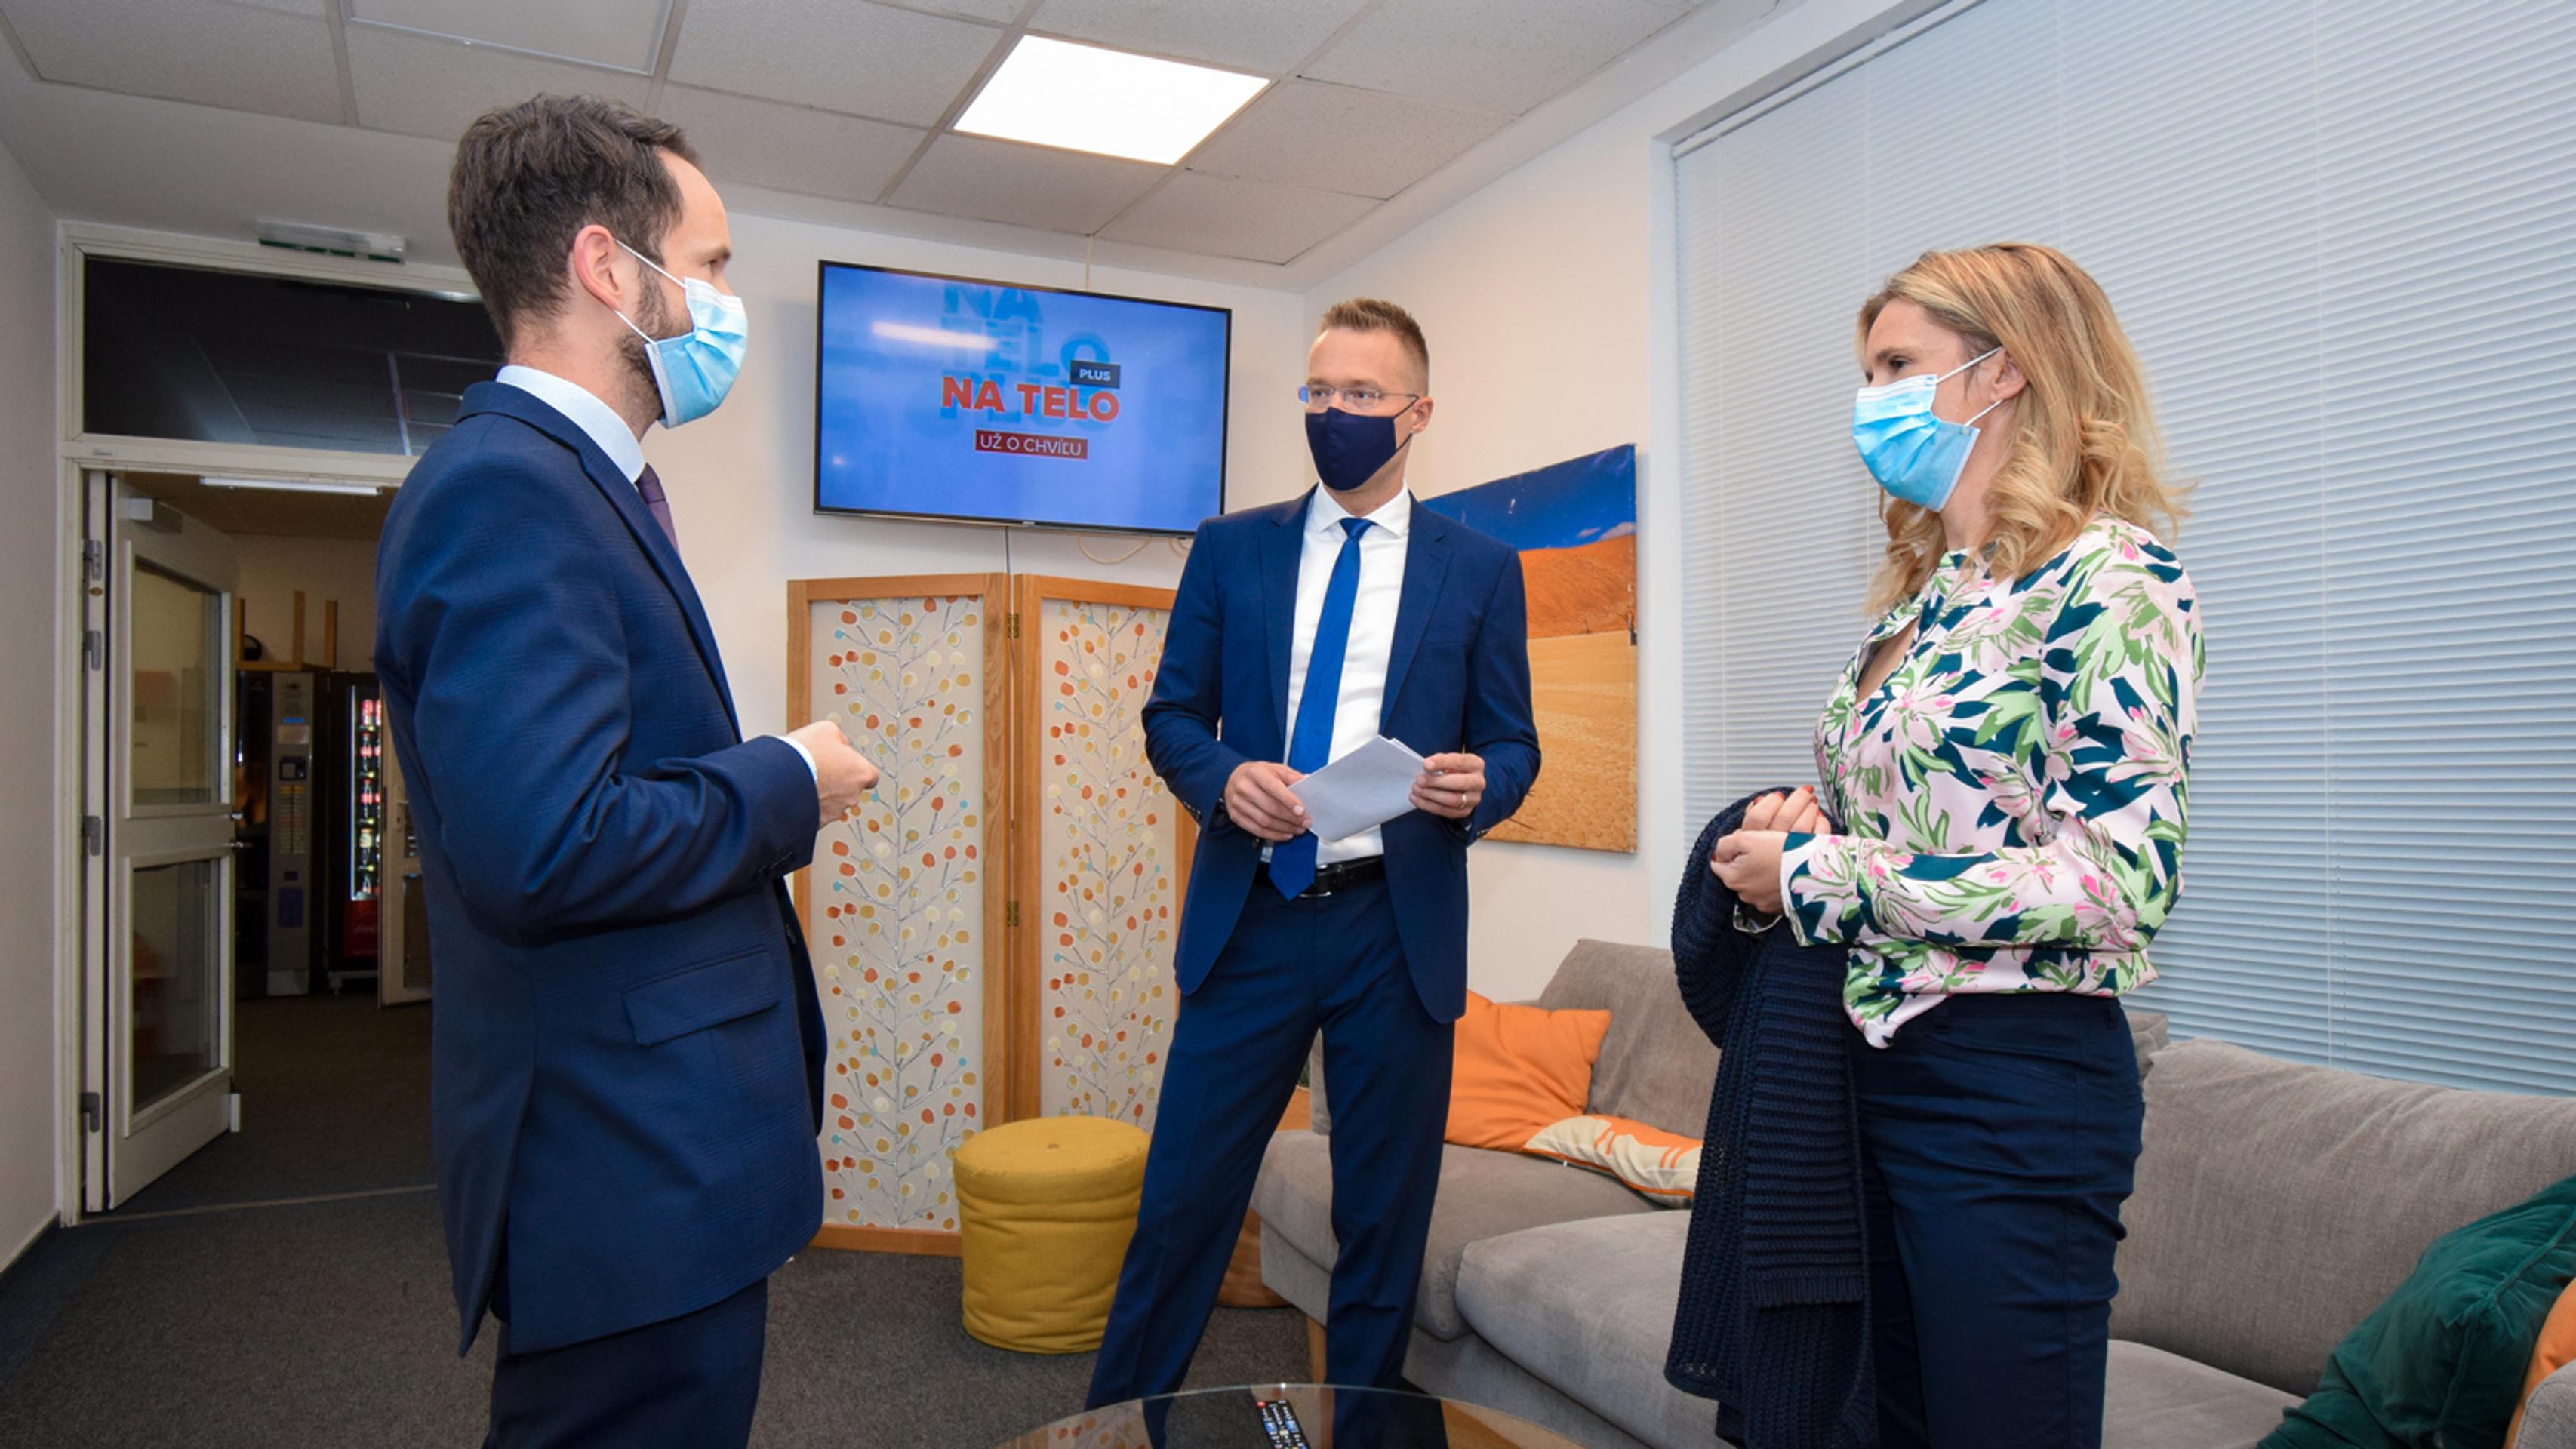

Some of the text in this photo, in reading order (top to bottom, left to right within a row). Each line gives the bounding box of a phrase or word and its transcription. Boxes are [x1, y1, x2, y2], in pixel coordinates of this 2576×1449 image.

[1079, 368, 1111, 382] PLUS
[943, 377, 1005, 413] NA
[1016, 383, 1119, 423] TELO
[980, 432, 1002, 449] UŽ
[1006, 435, 1020, 451] O
